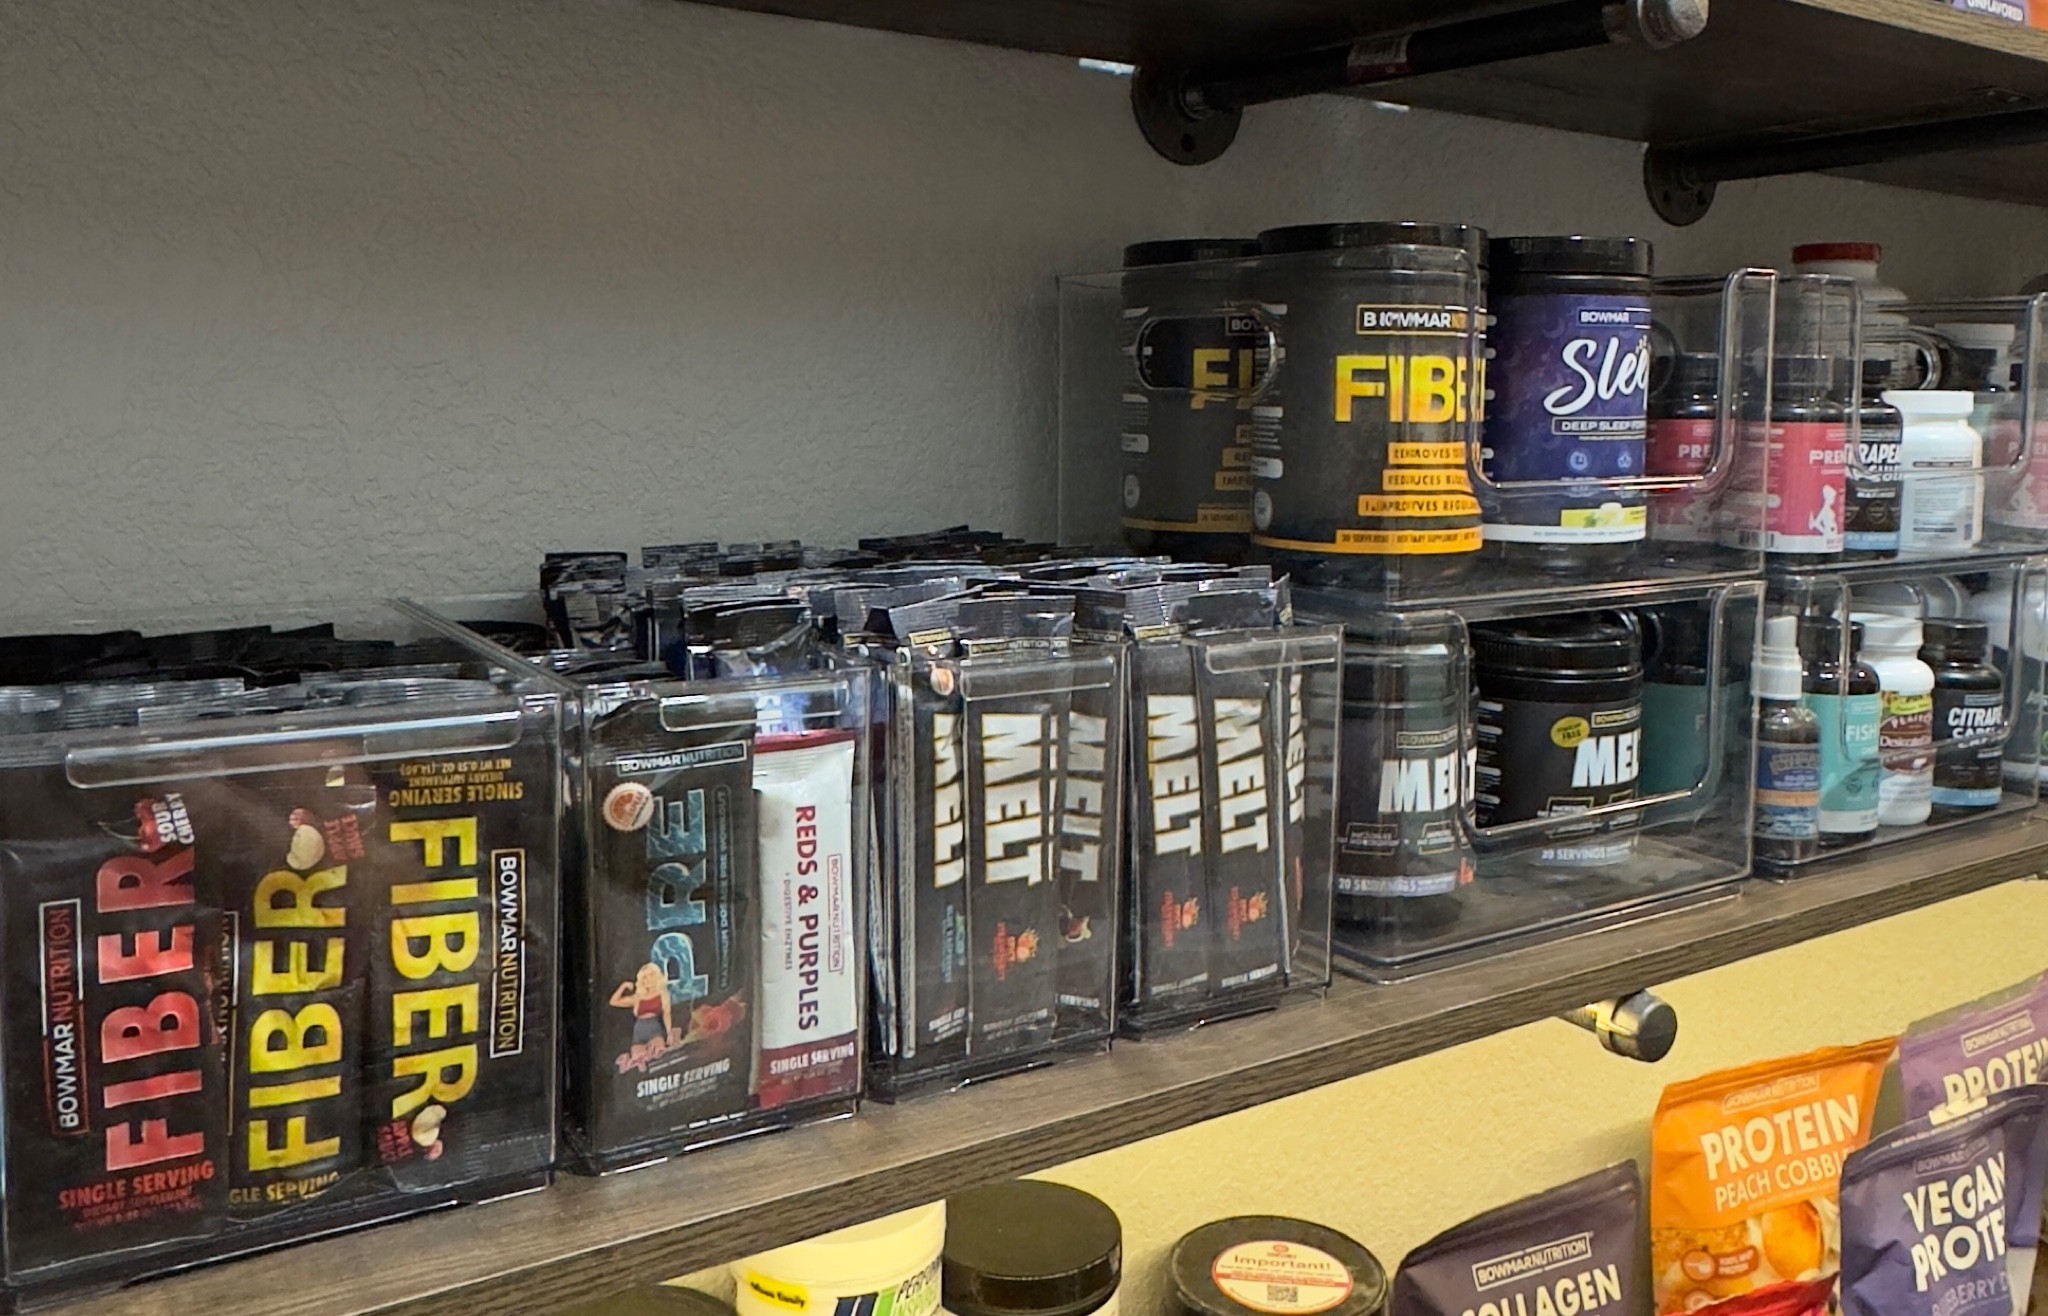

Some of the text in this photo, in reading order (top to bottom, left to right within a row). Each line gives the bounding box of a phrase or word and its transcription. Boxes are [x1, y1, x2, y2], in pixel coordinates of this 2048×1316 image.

[1561, 421, 1598, 431] DEEP
[387, 780, 525, 808] SINGLE SERVING
[980, 713, 1043, 889] MELT
[1147, 694, 1200, 857] MELT
[1213, 698, 1270, 856] MELT
[152, 802, 178, 843] SOUR
[164, 791, 196, 845] CHERRY
[645, 787, 709, 1006] PRE
[795, 805, 820, 1031] REDS & PURPLES
[1338, 878, 1352, 890] 20
[389, 815, 480, 1120] FIBER
[497, 855, 519, 1051] BOWMARNUTRITION
[50, 908, 76, 1129] BOWMARNUTRITION
[95, 845, 206, 1172] FIBER
[247, 863, 348, 1172] FIBER
[636, 1073, 681, 1098] SINGLE
[682, 1058, 731, 1085] SERVING
[770, 1053, 809, 1075] SINGLE
[810, 1041, 855, 1066] SERVING
[1699, 1093, 1860, 1182] PROTEIN
[58, 1178, 127, 1211] SINGLE
[132, 1160, 215, 1195] SERVING
[1714, 1168, 1772, 1213] PEACH
[1903, 1150, 2006, 1234] VEGAN
[1234, 1255, 1332, 1271] Important!
[1476, 1238, 1587, 1284] BOWMARNUTRITION
